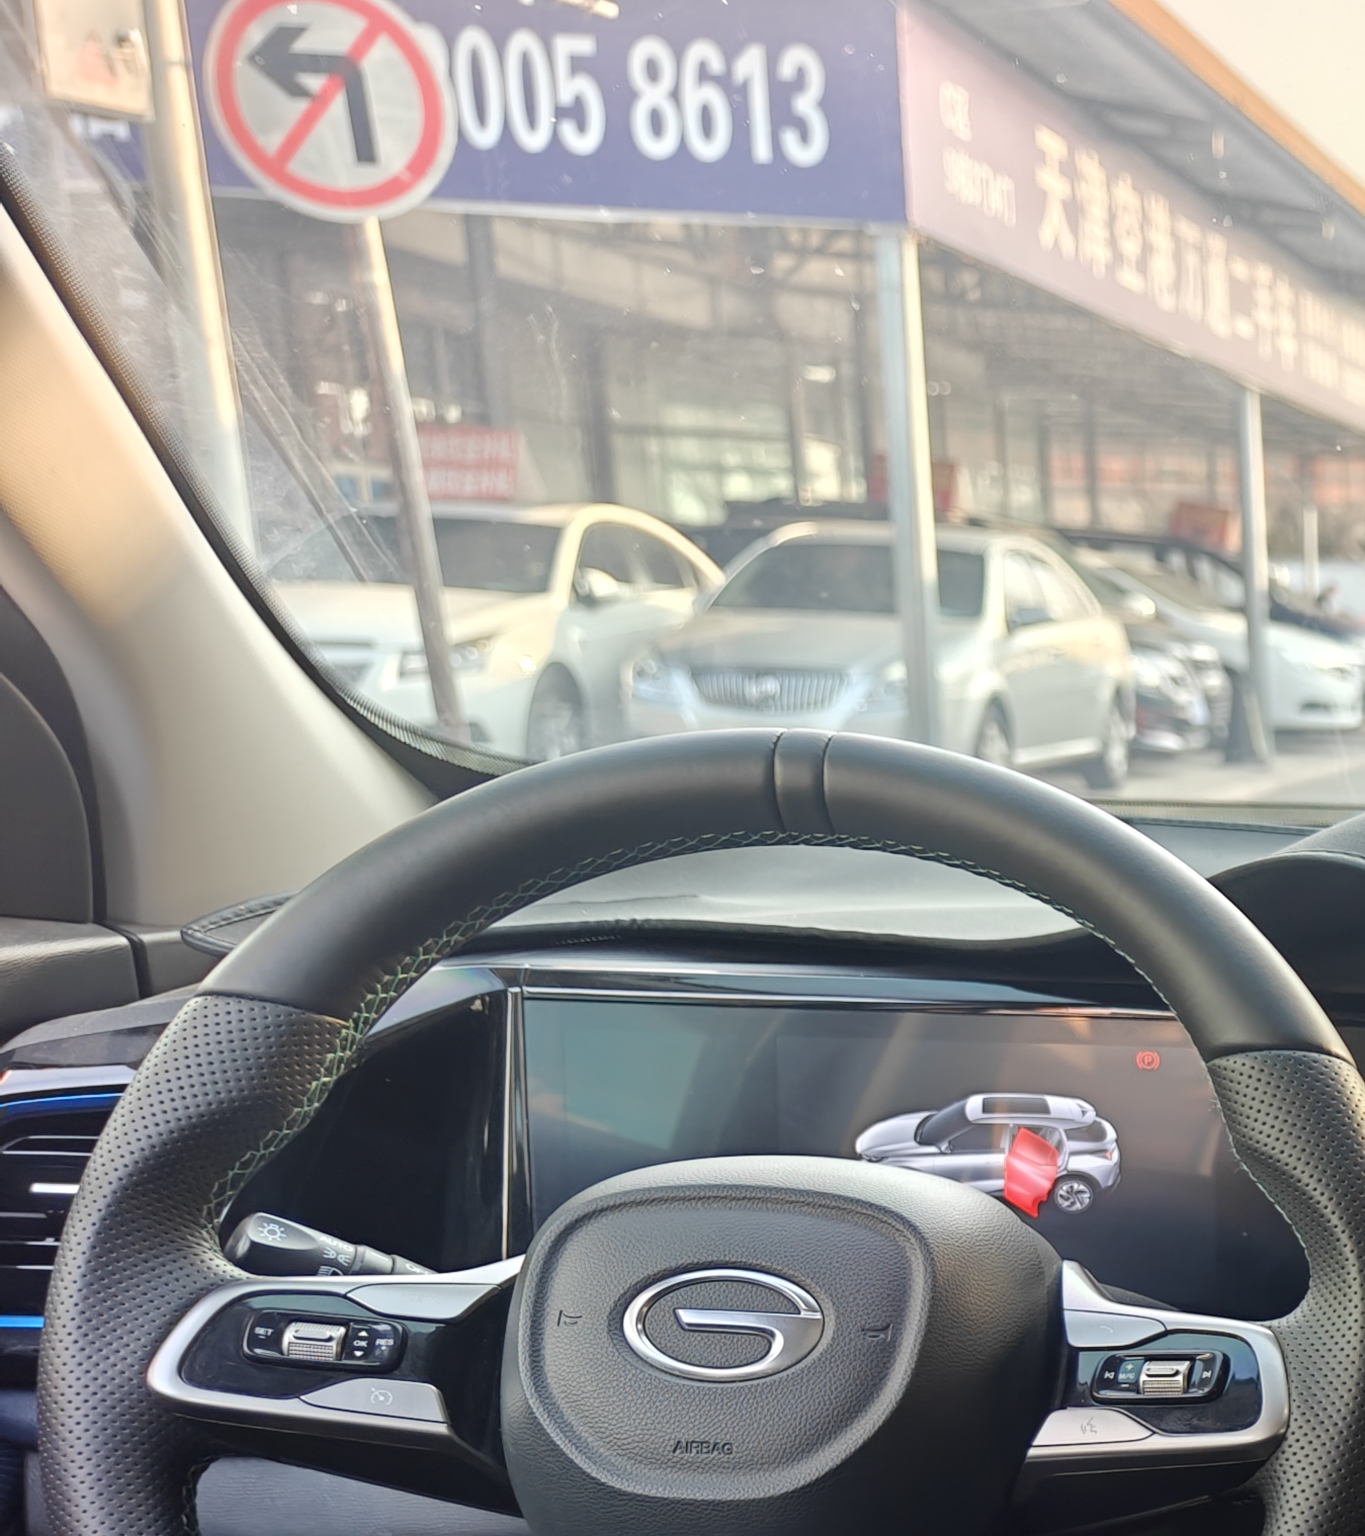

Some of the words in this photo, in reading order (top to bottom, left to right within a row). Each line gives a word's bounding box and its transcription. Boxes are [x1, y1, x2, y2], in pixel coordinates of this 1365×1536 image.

[627, 35, 829, 168] 8613
[319, 1236, 354, 1251] AUTO
[254, 1326, 274, 1336] SET
[375, 1338, 394, 1346] RES
[672, 1440, 734, 1455] AIRBAG
